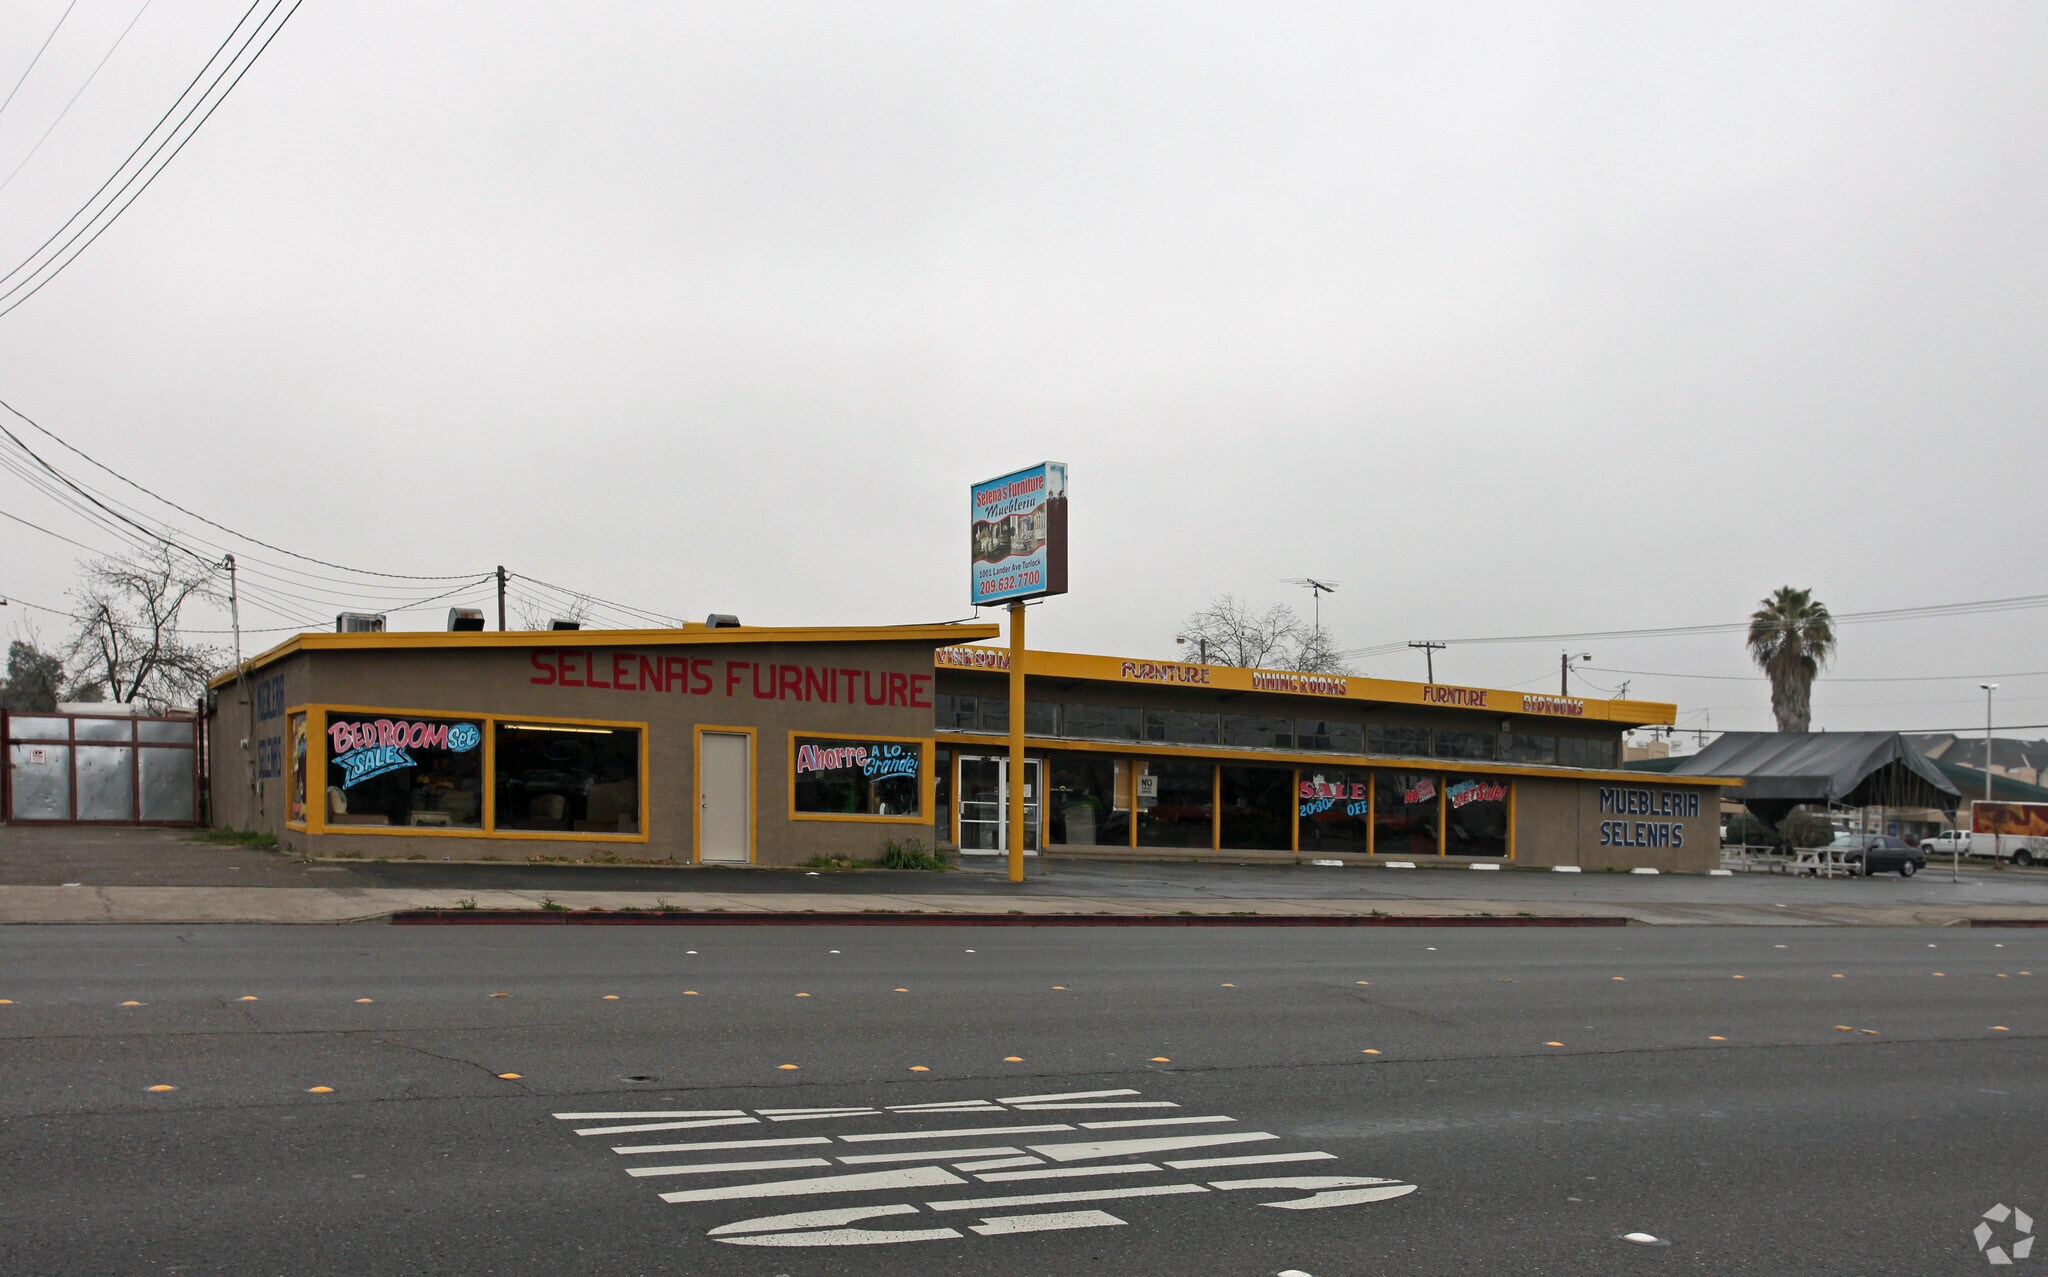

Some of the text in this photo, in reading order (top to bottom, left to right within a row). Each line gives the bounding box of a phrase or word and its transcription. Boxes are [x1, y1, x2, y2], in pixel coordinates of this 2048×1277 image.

[976, 475, 1044, 507] Selena's Furniture
[985, 496, 1036, 519] Muebleria
[993, 565, 1011, 576] Lander
[1011, 563, 1021, 572] Ave
[1022, 558, 1041, 569] Turlock
[979, 570, 1040, 595] 209.632.7700
[726, 661, 932, 708] FURNITURE
[1252, 672, 1347, 696] DINING ROOMS
[1523, 694, 1584, 717] BEDROOMS
[328, 718, 477, 753] BEDROOM Set
[354, 745, 396, 774] SALE
[797, 744, 867, 774] Ahorre
[871, 745, 880, 757] A
[1141, 778, 1152, 787] NO
[1300, 781, 1366, 799] SALE
[1347, 800, 1368, 816] OFF
[1599, 787, 1700, 817] MUEBLERIA
